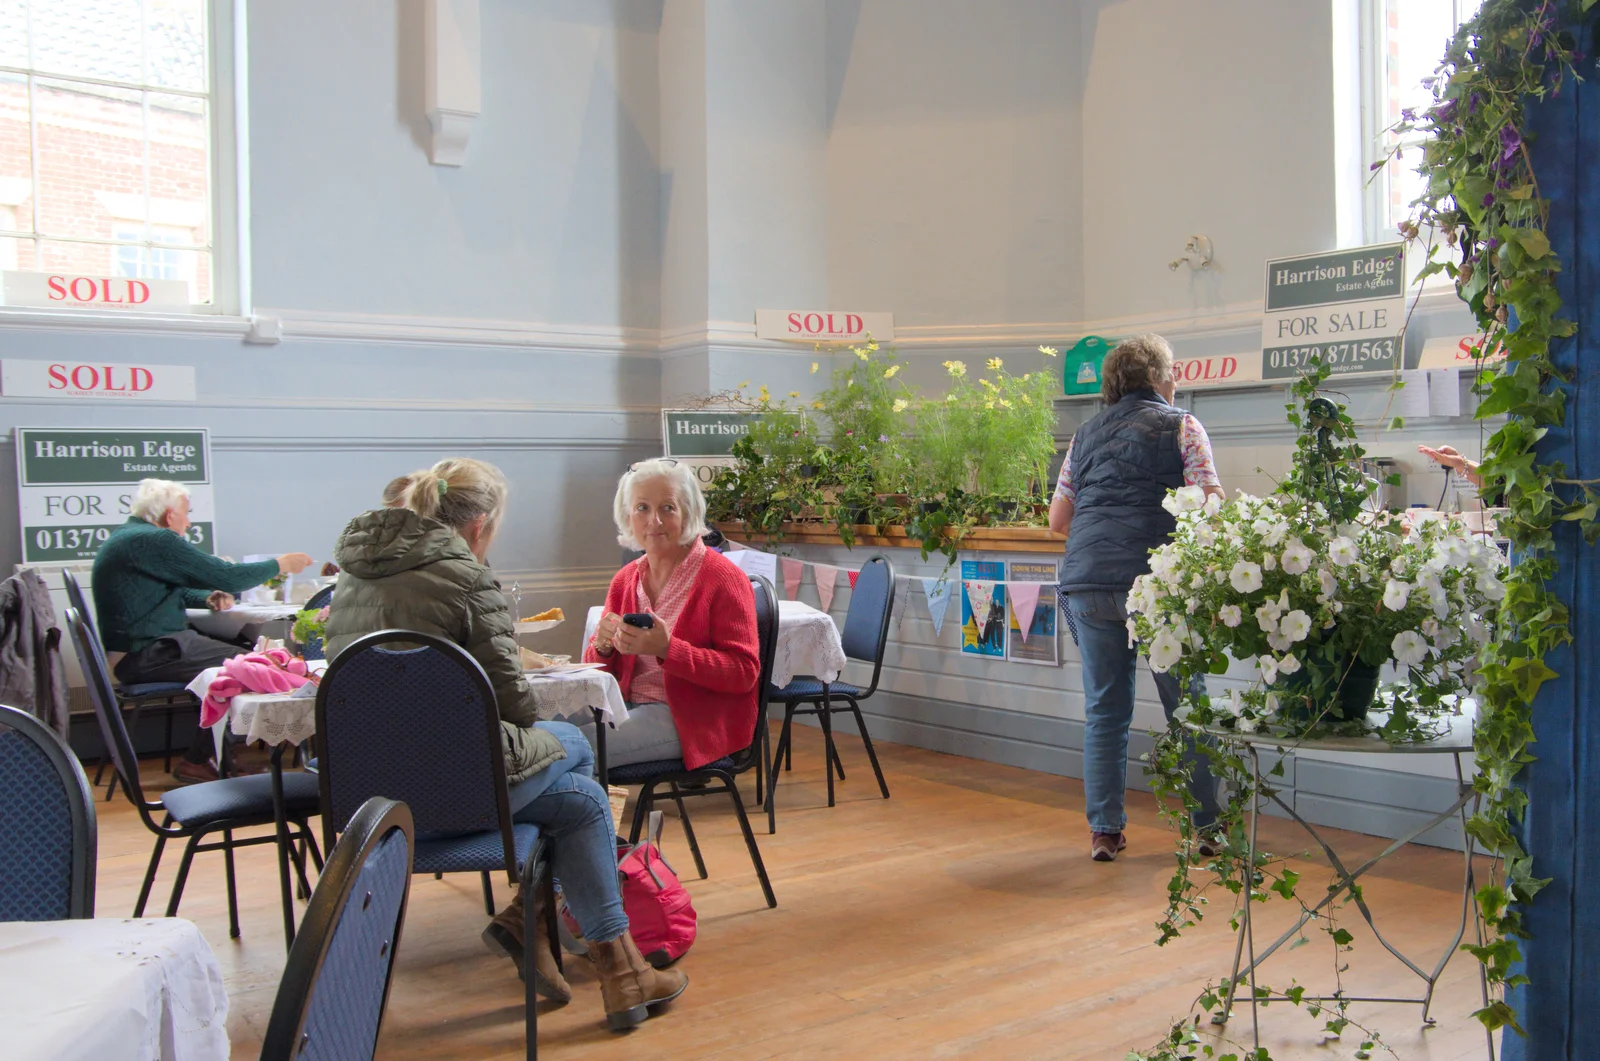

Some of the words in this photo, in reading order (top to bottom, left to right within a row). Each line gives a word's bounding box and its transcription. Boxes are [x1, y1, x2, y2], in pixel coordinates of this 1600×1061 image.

[1275, 264, 1346, 286] Harrison
[1352, 257, 1395, 279] Edge
[47, 275, 150, 304] SOLD
[1336, 280, 1362, 292] Estate
[1363, 277, 1394, 290] Agents
[787, 312, 864, 334] SOLD
[1277, 316, 1319, 338] FOR
[1328, 308, 1388, 333] SALE
[1327, 340, 1393, 364] 871563
[47, 363, 154, 392] SOLD
[676, 420, 750, 435] Harrison
[34, 440, 136, 458] Harrison
[142, 440, 196, 461] Edge
[123, 462, 158, 472] Estate
[160, 462, 197, 474] Agents
[44, 495, 105, 516] FOR
[36, 528, 110, 549] 01379
[1012, 564, 1030, 573] DOWN
[1030, 565, 1042, 573] THE
[1042, 566, 1055, 574] LINE
